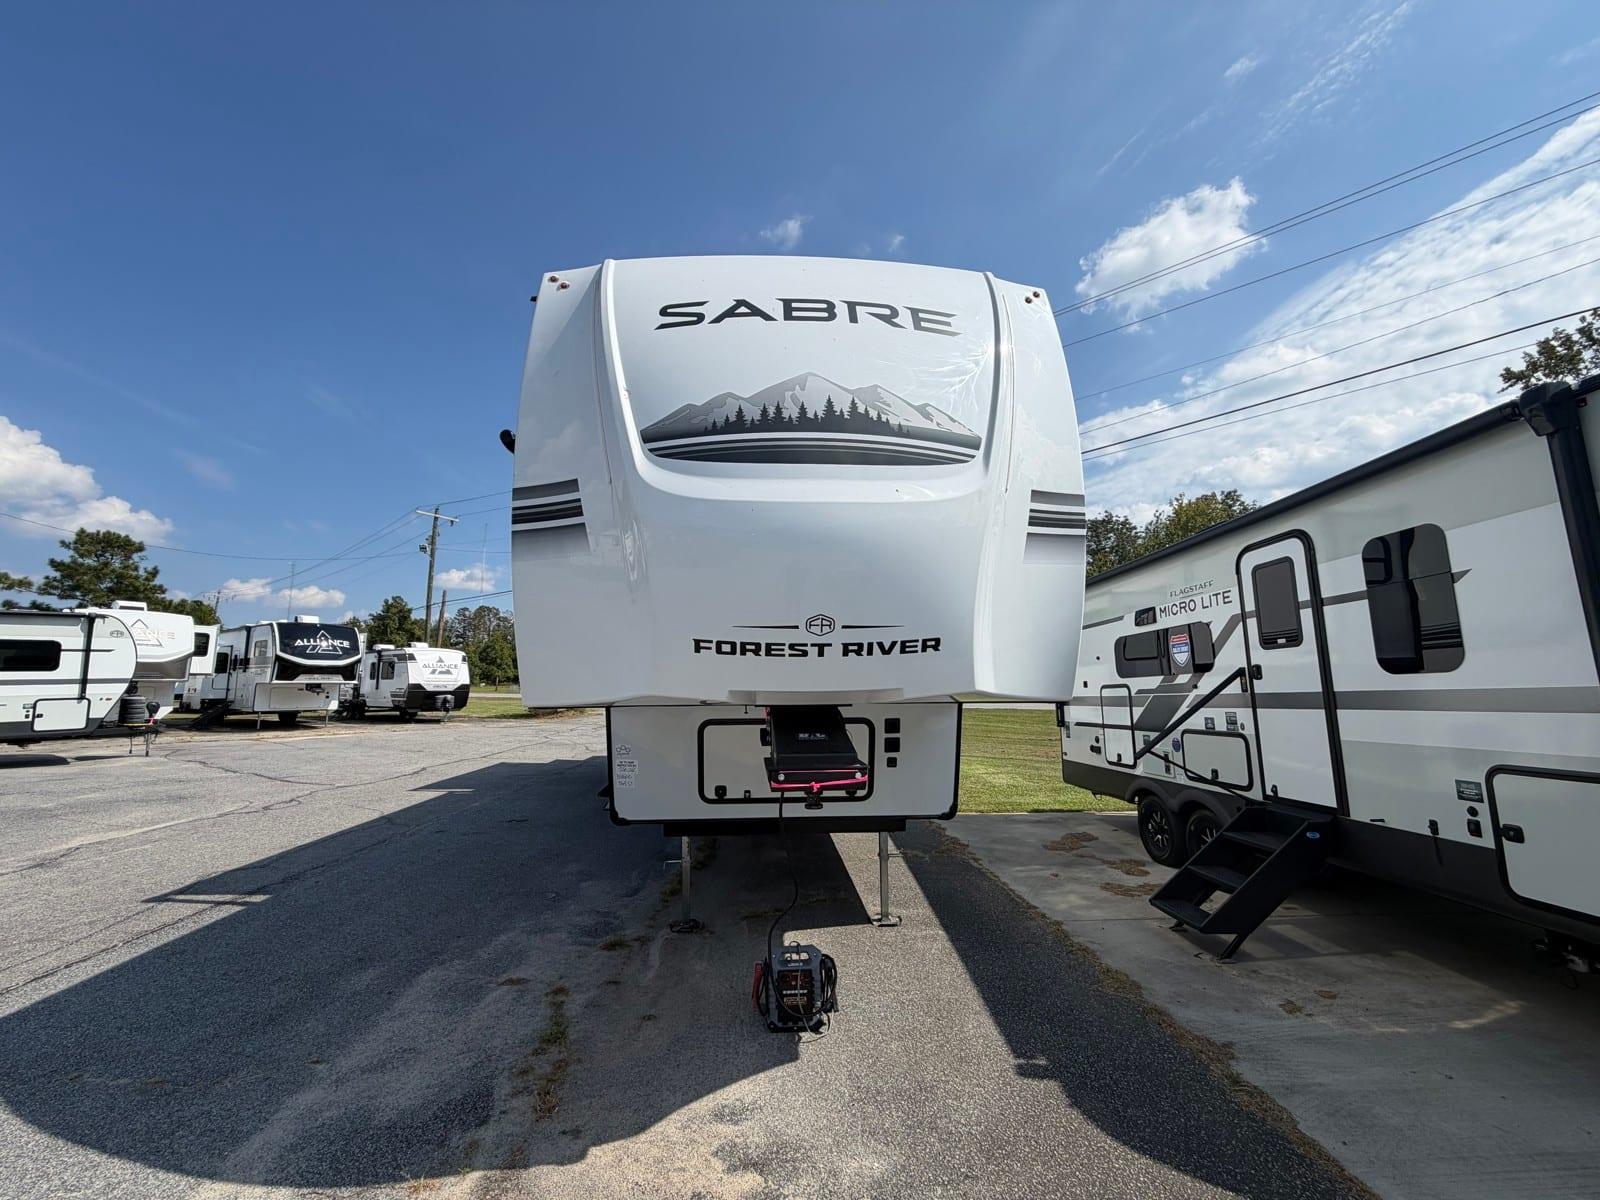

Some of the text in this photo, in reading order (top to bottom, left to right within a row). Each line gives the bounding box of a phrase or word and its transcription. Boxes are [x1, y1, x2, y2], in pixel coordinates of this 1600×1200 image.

[654, 298, 963, 337] SABRE
[1169, 580, 1214, 597] FLAGSTAFF
[1159, 590, 1232, 618] MICRO LITE
[692, 637, 942, 658] FOREST RIVER
